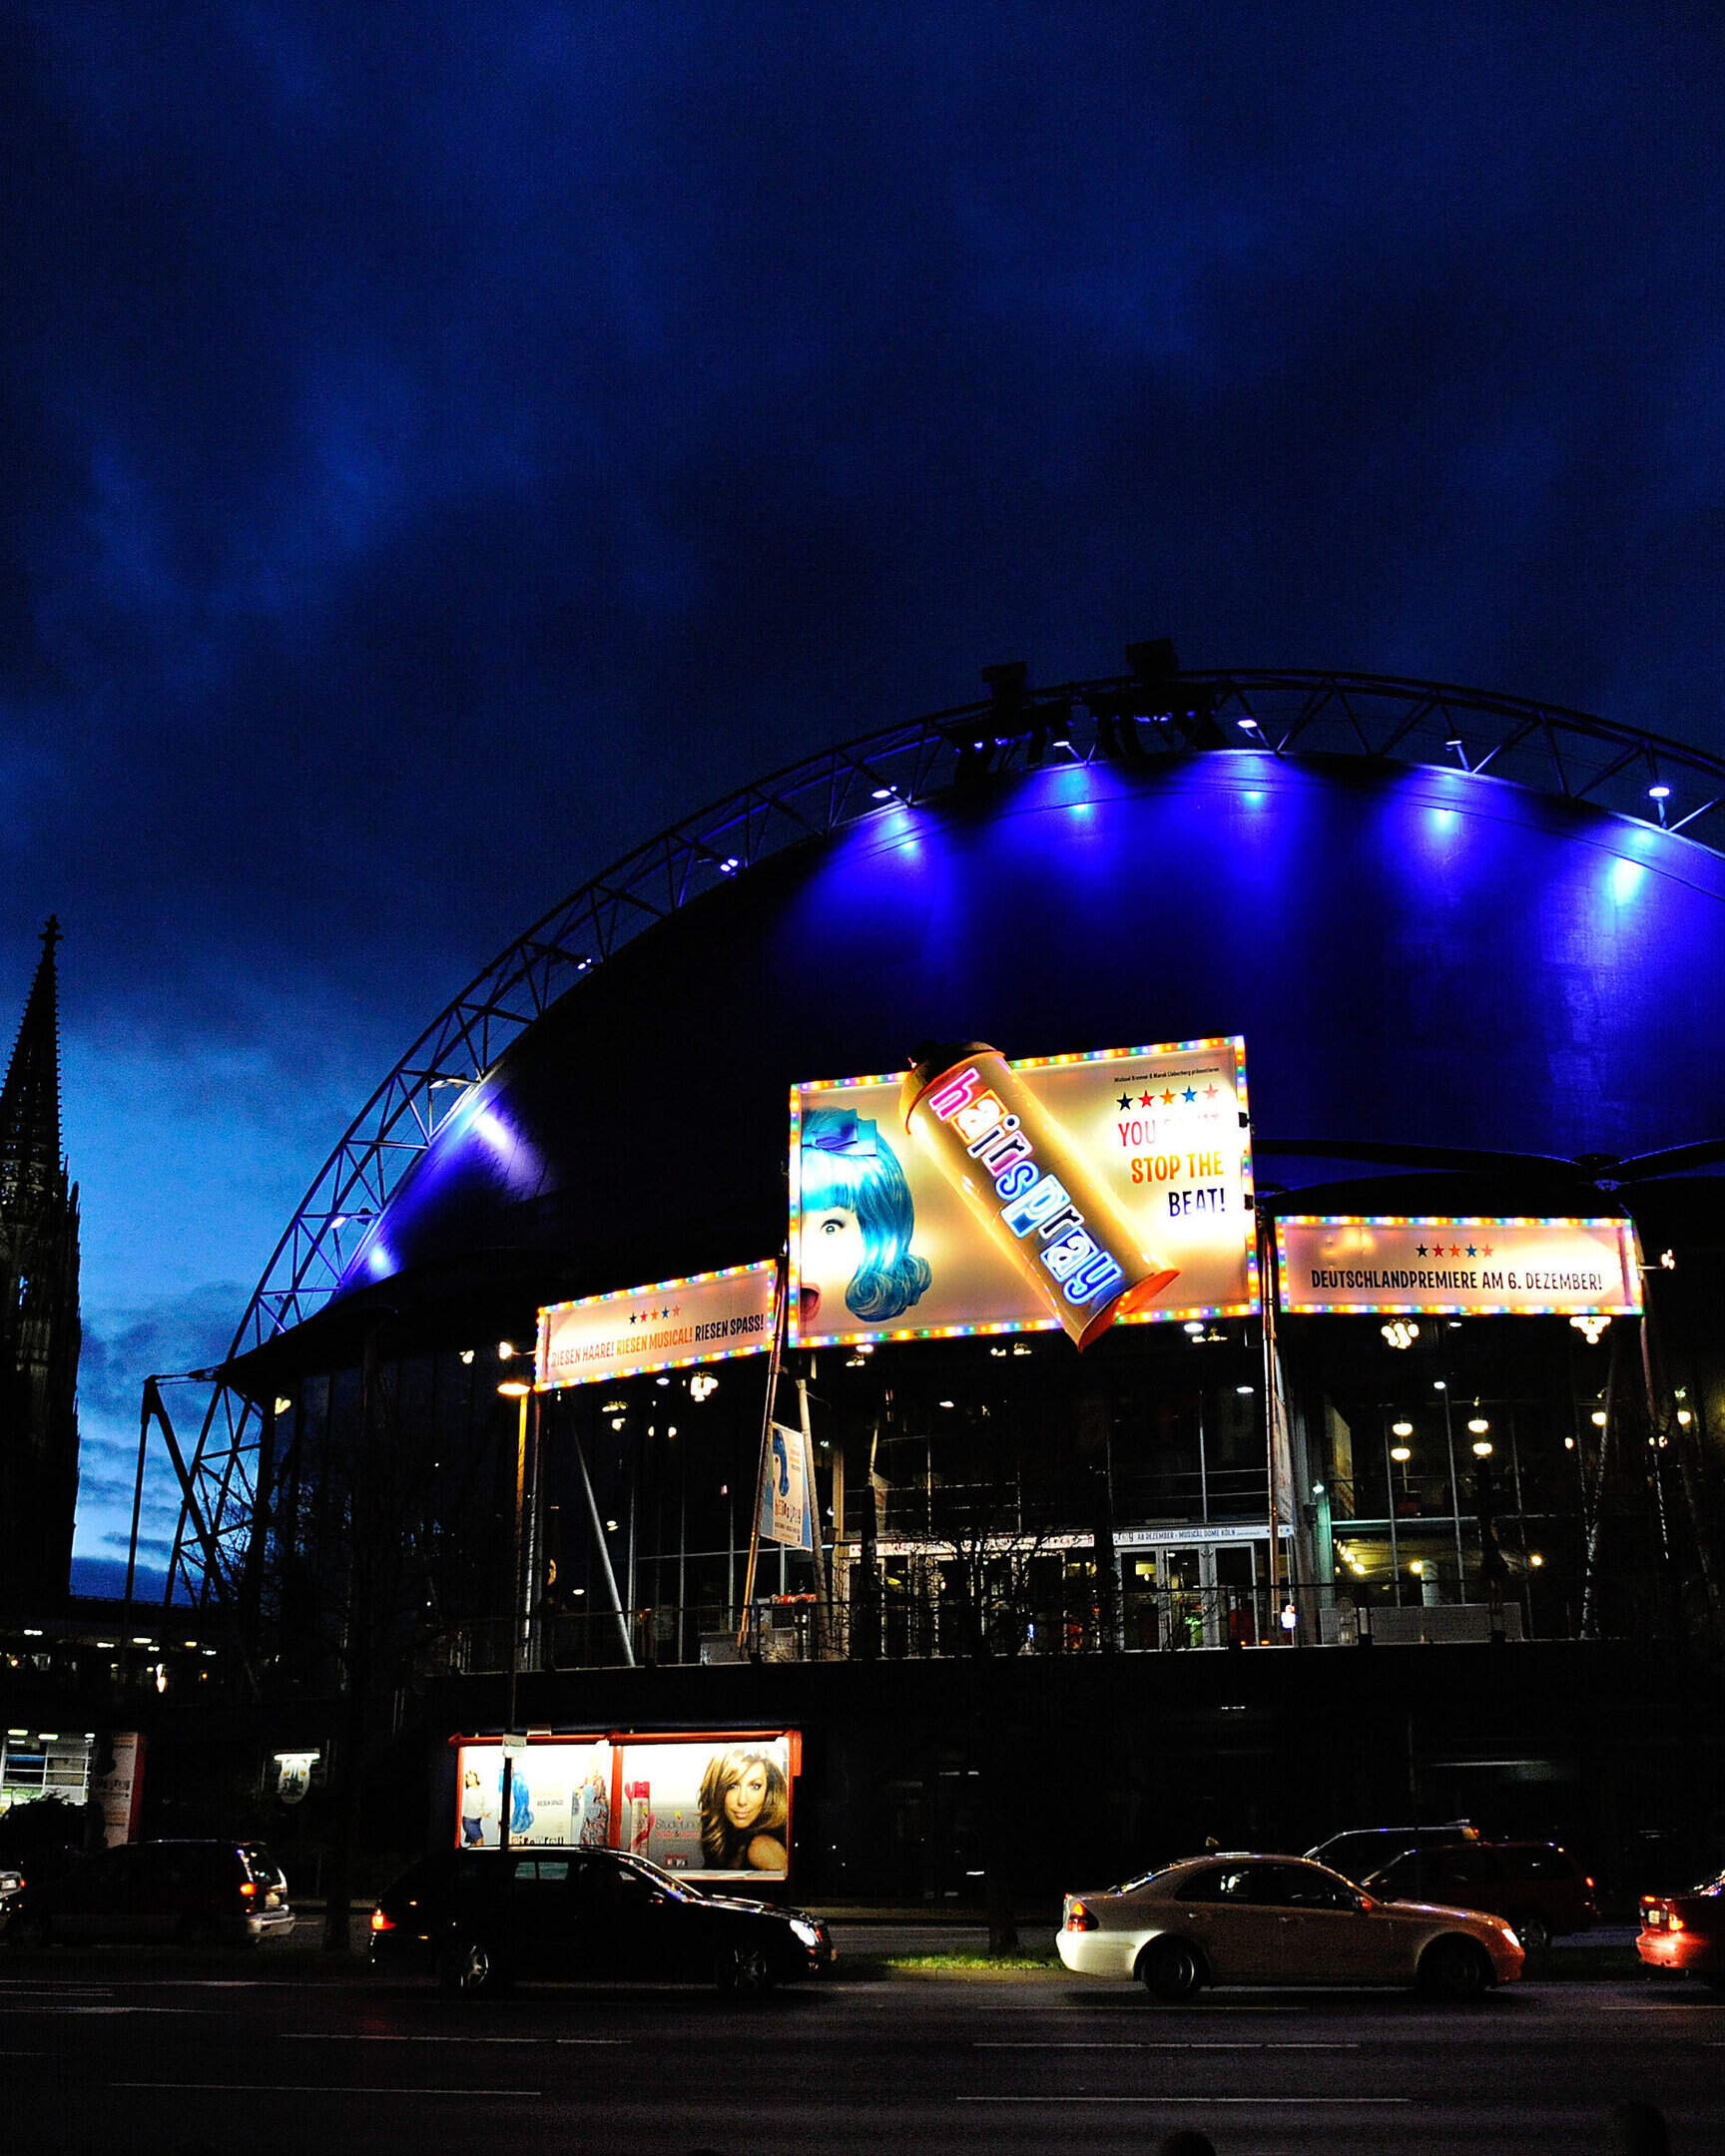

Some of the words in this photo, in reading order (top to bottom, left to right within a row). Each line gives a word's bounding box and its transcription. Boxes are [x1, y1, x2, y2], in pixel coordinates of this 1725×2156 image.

[1118, 1119, 1156, 1148] YOU
[1131, 1155, 1181, 1184] STOP
[1186, 1151, 1225, 1179] THE
[928, 1066, 1124, 1306] hairspray
[1168, 1188, 1226, 1217] BEAT!
[1311, 1270, 1478, 1289] DEUTSCHLANDPREMIERE
[1482, 1272, 1503, 1290] AM
[1507, 1272, 1521, 1290] 6.
[1525, 1272, 1603, 1291] DEZEMBER!
[582, 1342, 615, 1362] HAARE!
[616, 1335, 647, 1356] RIESEN
[649, 1326, 694, 1350] MUSICAL!
[695, 1320, 729, 1343] RIESEN
[730, 1314, 765, 1336] SPASS!
